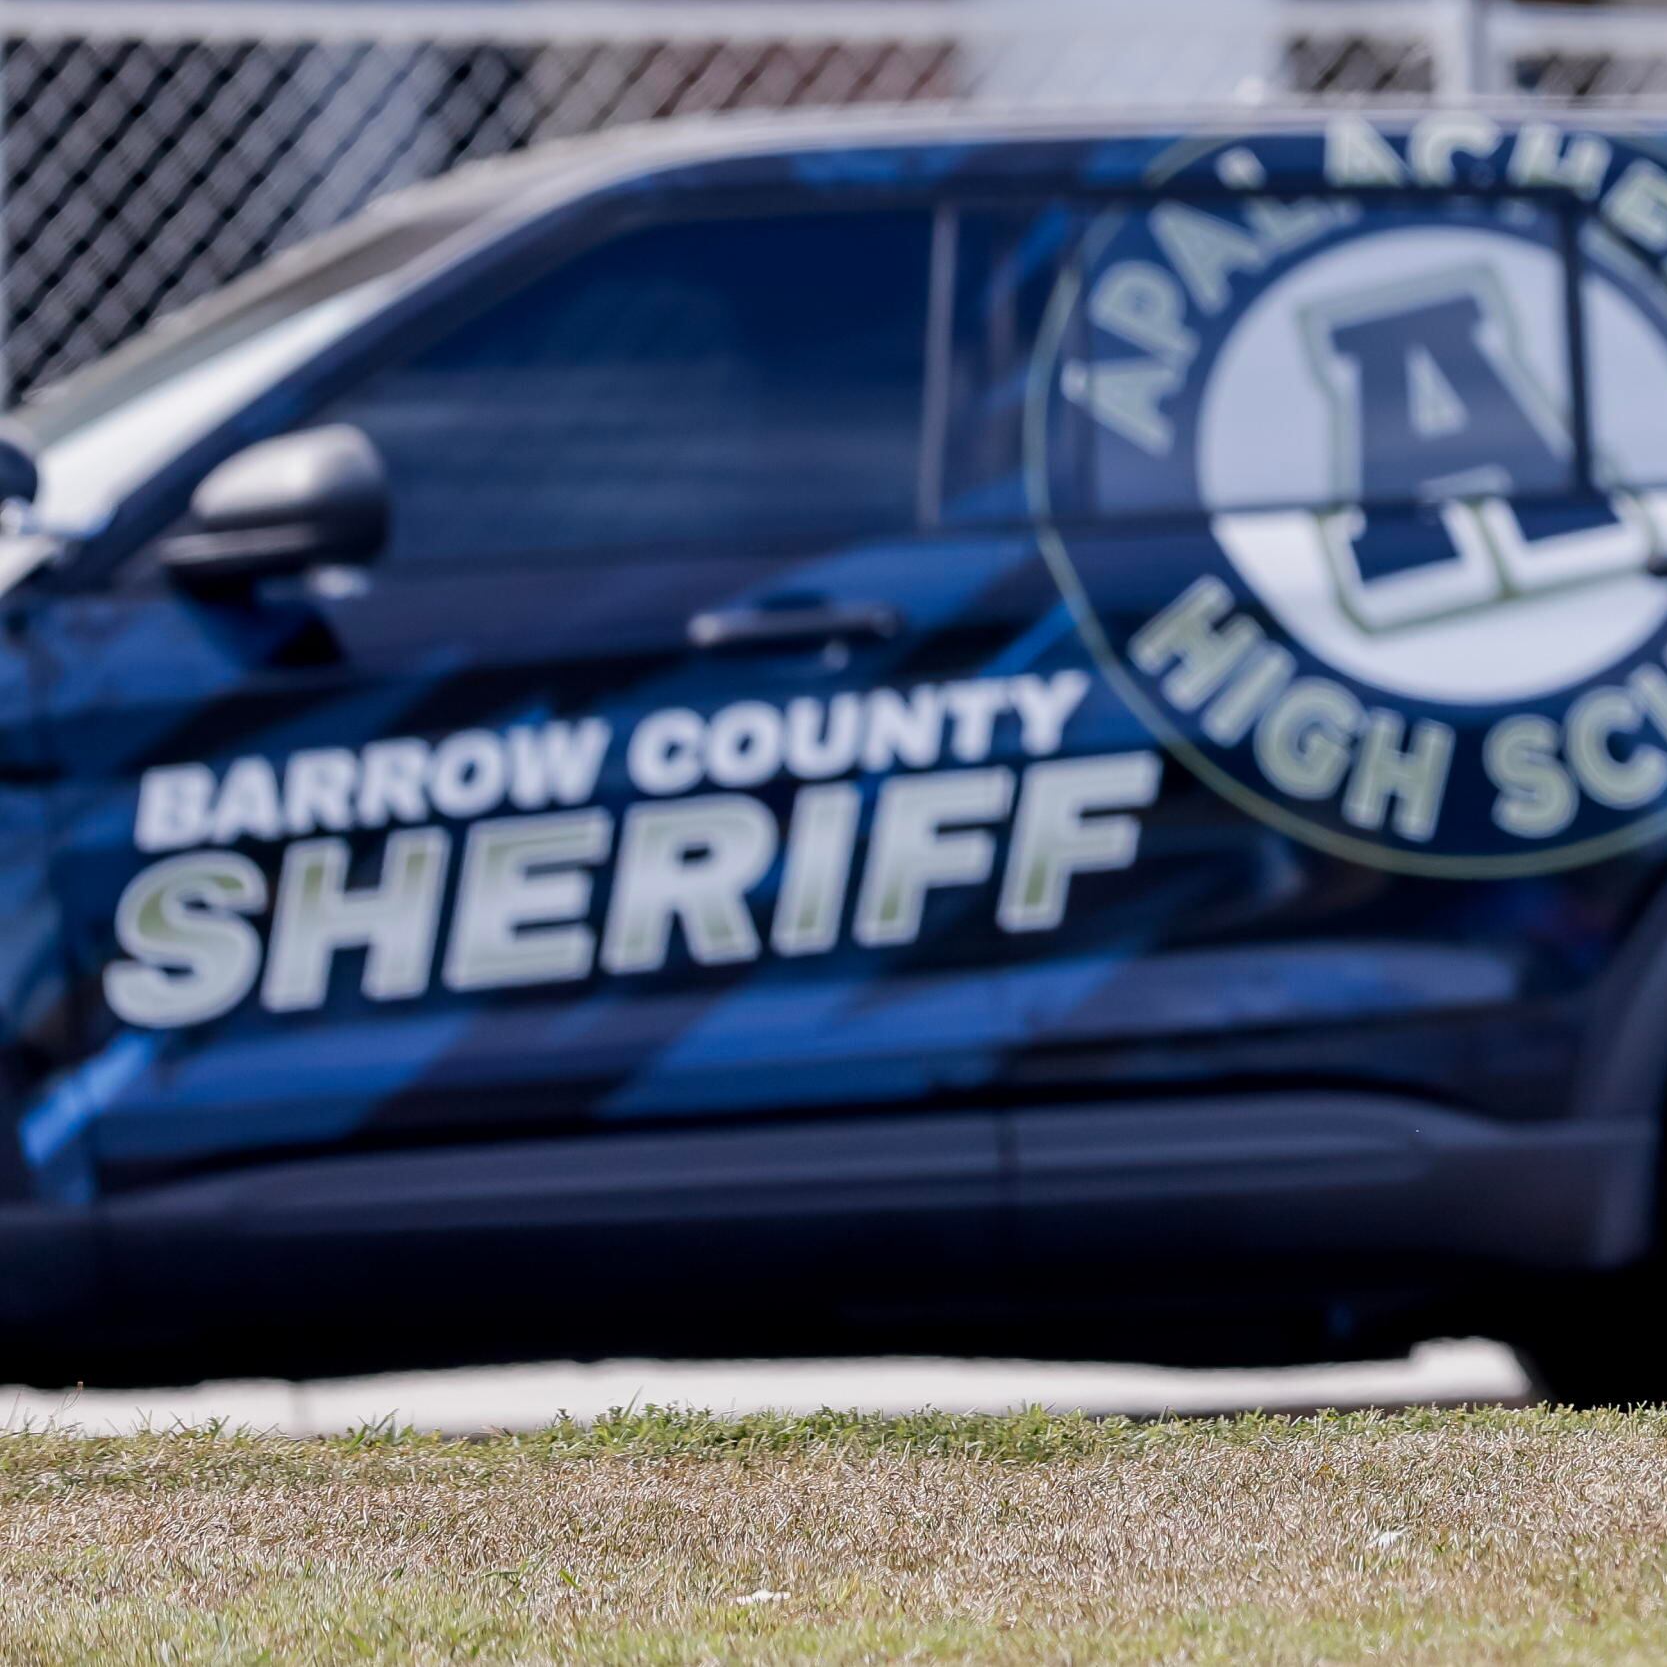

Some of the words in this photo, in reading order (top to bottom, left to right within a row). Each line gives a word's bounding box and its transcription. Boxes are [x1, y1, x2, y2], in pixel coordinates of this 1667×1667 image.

[1308, 272, 1648, 622] A
[133, 716, 611, 852] BARROW
[627, 669, 1091, 796] COUNTY
[1128, 575, 1457, 842] HIGH
[102, 752, 1163, 1030] SHERIFF
